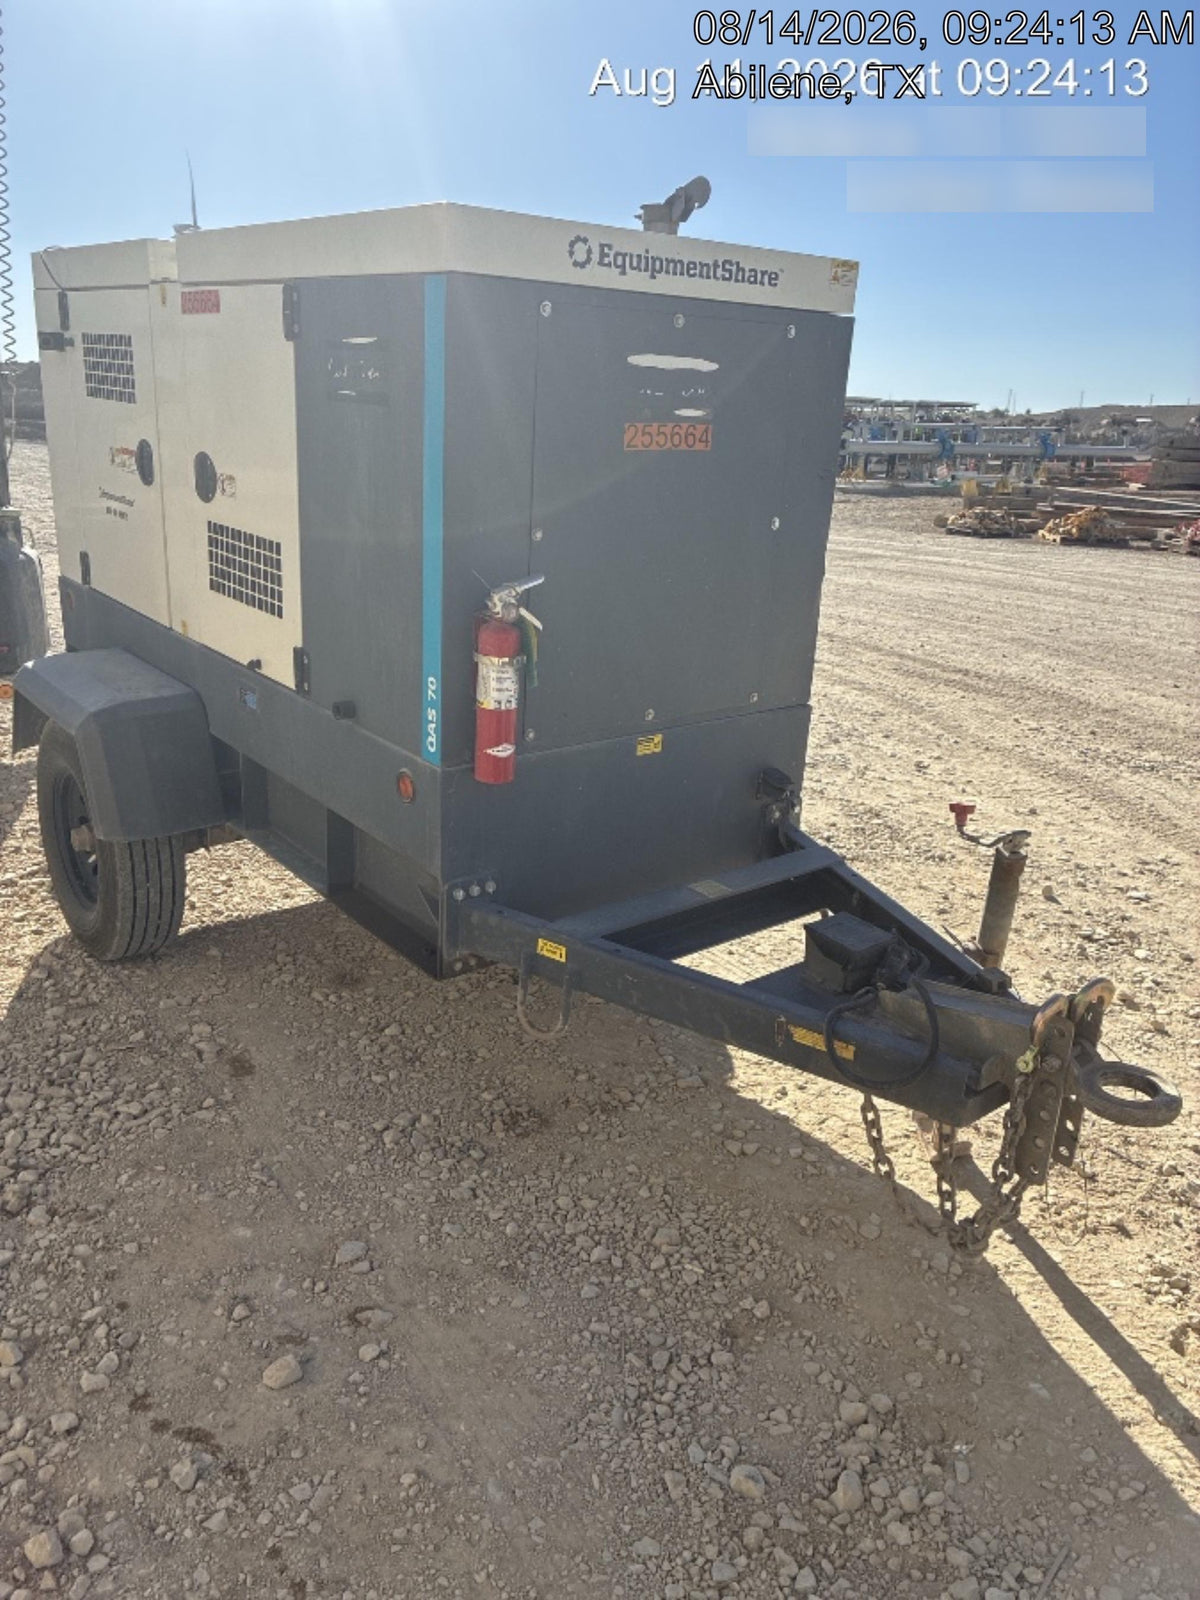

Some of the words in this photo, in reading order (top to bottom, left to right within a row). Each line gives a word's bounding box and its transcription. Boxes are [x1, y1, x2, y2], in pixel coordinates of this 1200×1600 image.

[597, 243, 780, 288] EquipmentShare
[625, 424, 711, 449] 255664
[427, 676, 437, 701] 70
[426, 707, 437, 753] QAS
